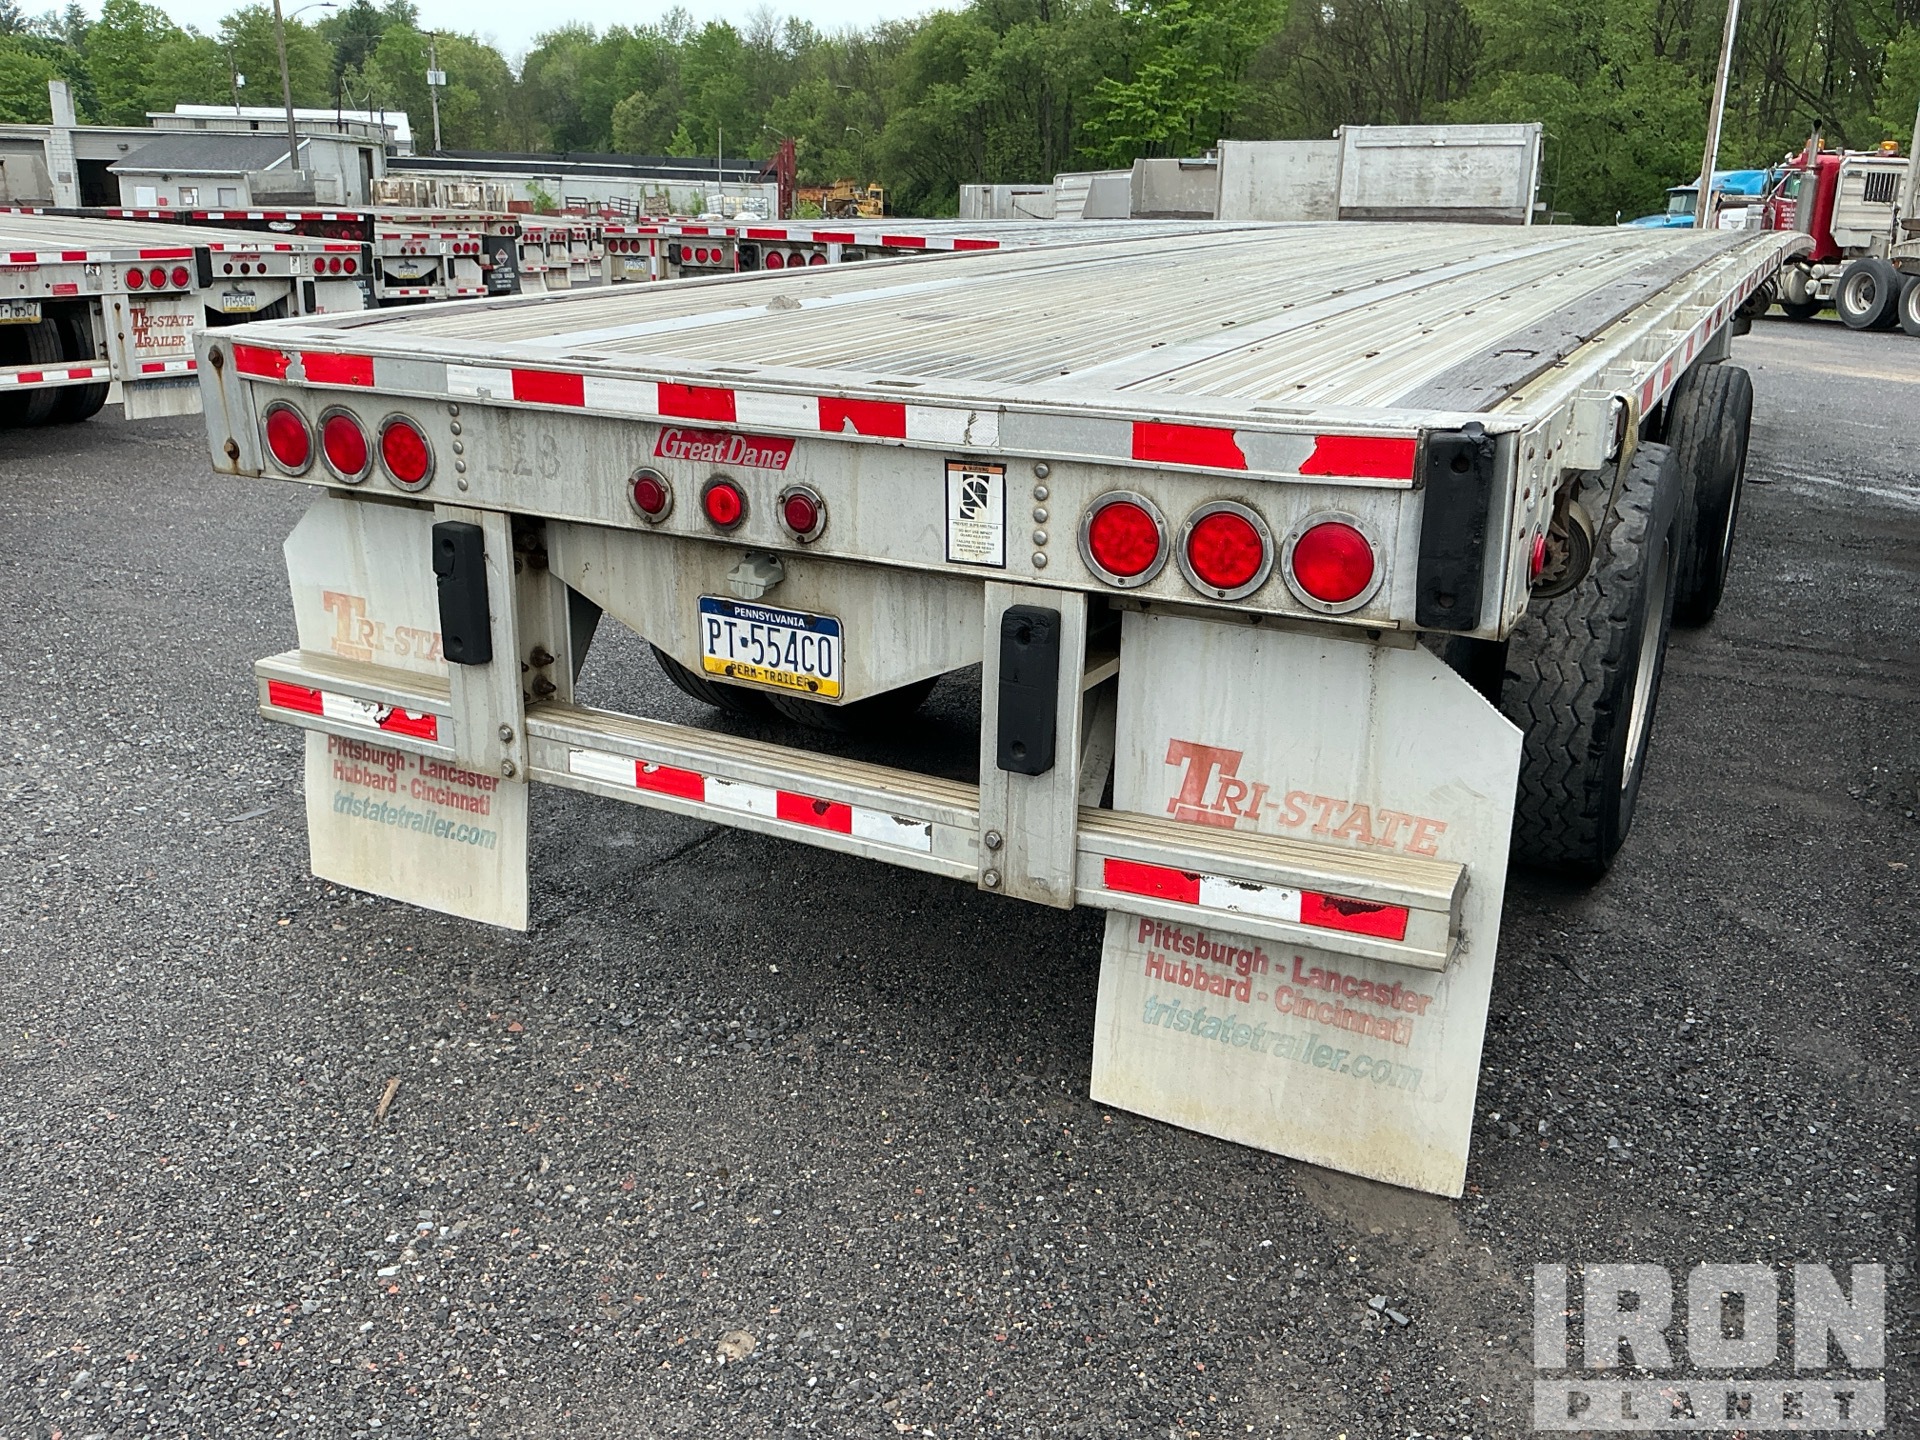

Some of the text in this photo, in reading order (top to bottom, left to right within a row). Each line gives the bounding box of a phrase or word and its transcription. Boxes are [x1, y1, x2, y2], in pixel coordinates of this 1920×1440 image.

[130, 308, 194, 328] TRI-STATE
[133, 328, 186, 348] TRAILER
[323, 591, 446, 662] TRI-STA
[734, 606, 805, 628] PENNSYLVANIA
[328, 735, 405, 773] Pittsburgh
[420, 756, 500, 793] Lancaster
[333, 760, 397, 793] Hubbard
[410, 778, 491, 816] Cincinnati
[333, 789, 497, 850] tristatetrailer.com
[1165, 737, 1448, 857] TRI-STATE
[1137, 918, 1270, 976] Pittsburgh
[1291, 956, 1433, 1017] Lancaster
[1144, 952, 1253, 1004] Hubbard
[1275, 985, 1414, 1048] Cincinnati
[1141, 994, 1423, 1092] tristatetrailer.com
